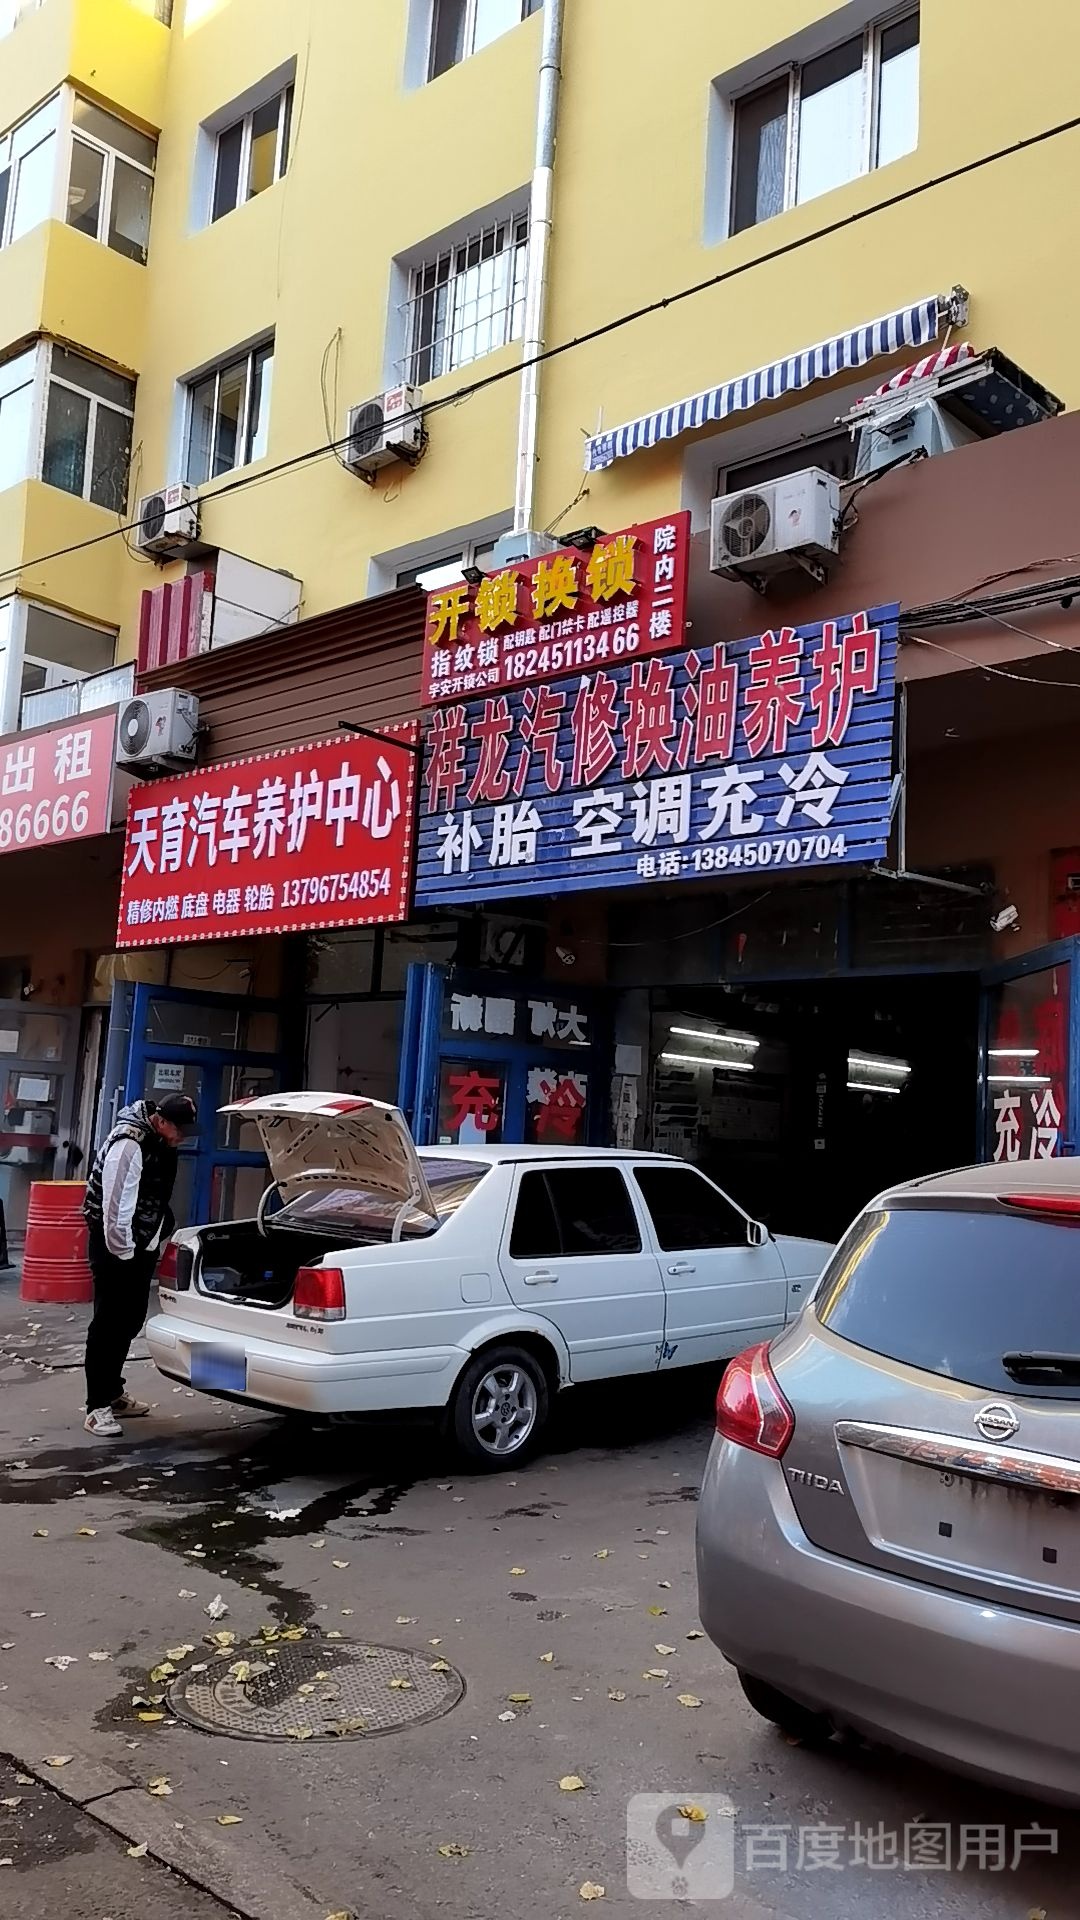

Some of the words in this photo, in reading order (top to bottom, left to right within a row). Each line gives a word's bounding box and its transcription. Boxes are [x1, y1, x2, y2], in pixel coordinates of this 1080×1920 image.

[428, 535, 638, 645] 开锁换锁
[649, 523, 677, 640] 院内二楼
[503, 629, 537, 651] 配钥匙
[538, 615, 586, 642] 配门禁卡
[587, 600, 640, 630] 配遥控器
[504, 622, 640, 681] 18245113466
[431, 637, 499, 678] 指纹锁
[425, 611, 881, 813] 祥龙汽修换油养护
[2, 730, 92, 796] 出租
[0, 791, 90, 848] 86666
[127, 755, 402, 877] 天育汽车养护中心
[436, 800, 544, 875] 补胎
[570, 751, 850, 857] 空调充冷
[126, 895, 179, 925] 精修内燃
[181, 892, 209, 919] 底盘
[212, 888, 241, 915] 电器
[244, 884, 275, 911] 轮胎
[281, 868, 391, 908] 13796754854
[993, 1089, 1061, 1162] 充冷
[979, 1415, 1015, 1428] NISSAN
[787, 1467, 845, 1496] TIIDA
